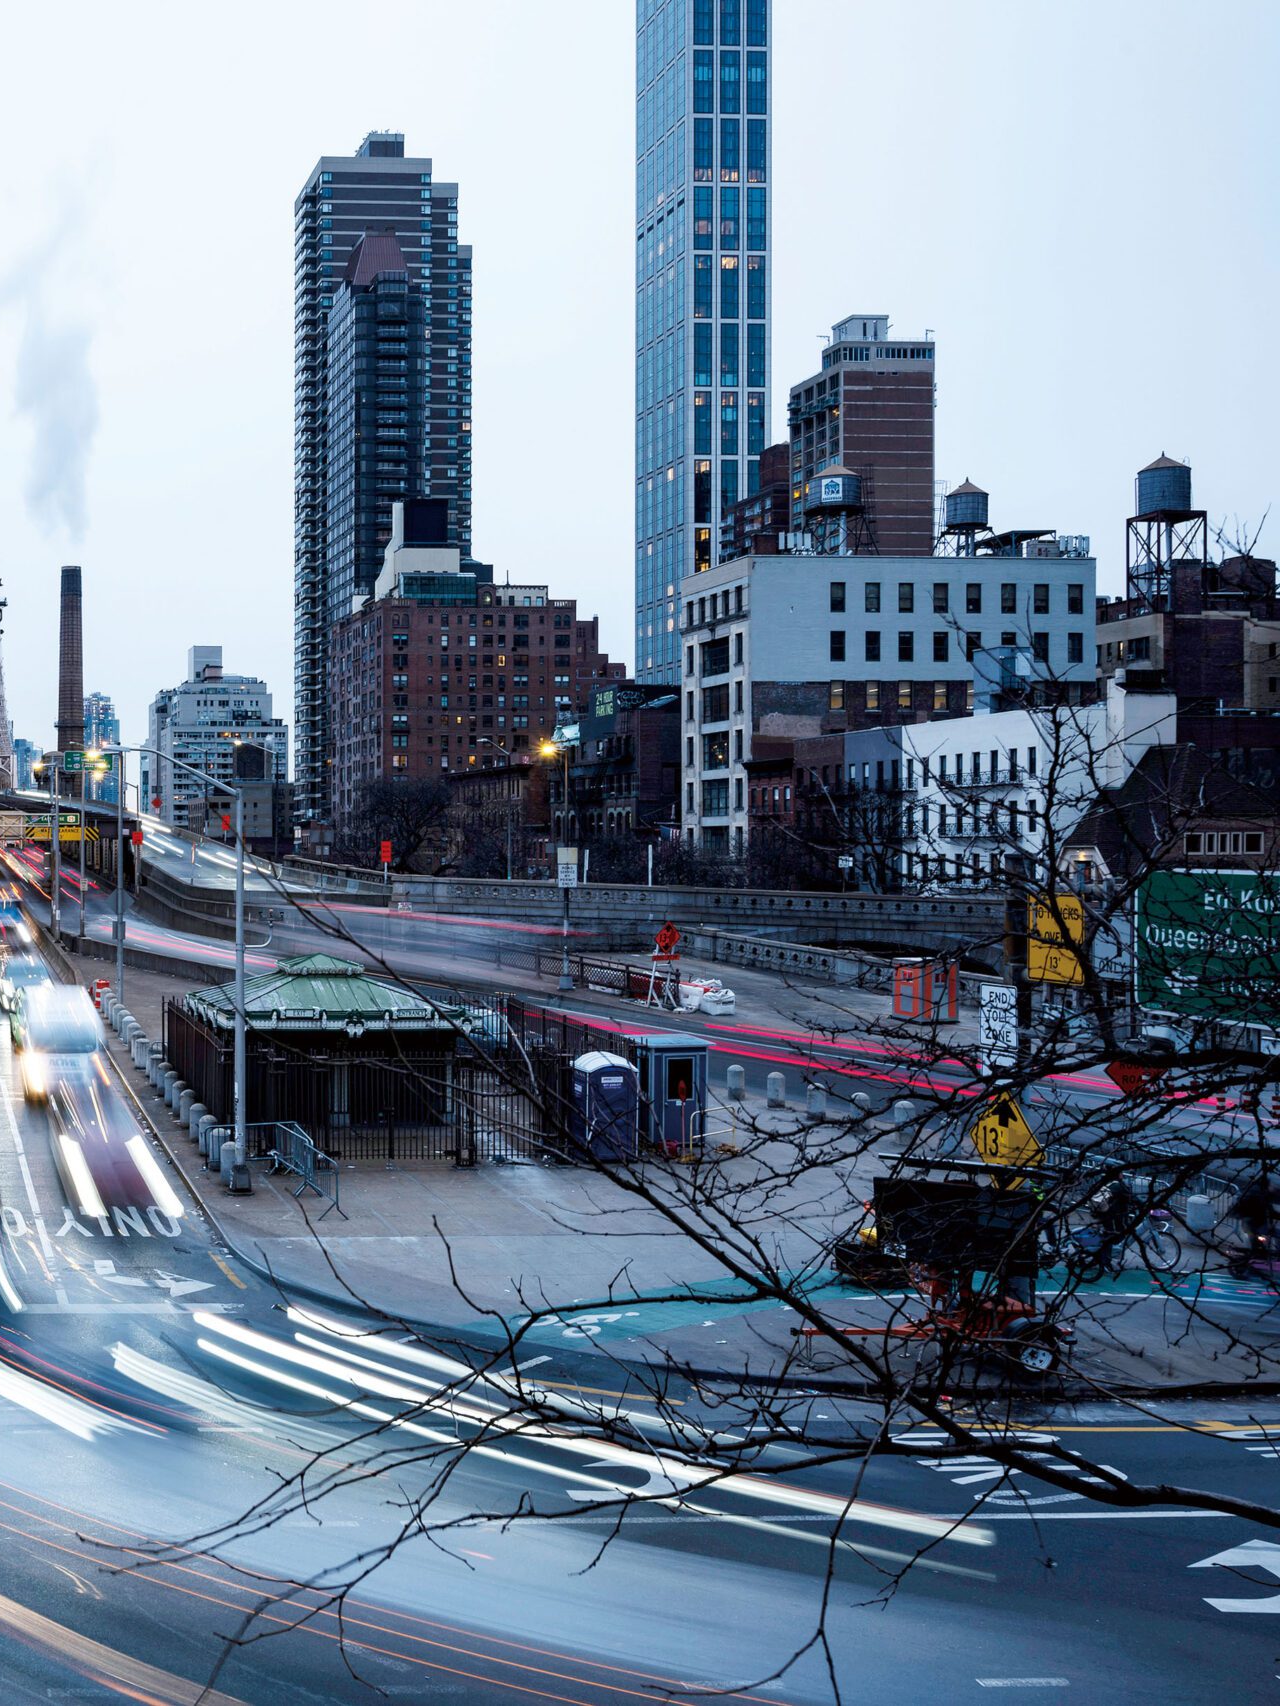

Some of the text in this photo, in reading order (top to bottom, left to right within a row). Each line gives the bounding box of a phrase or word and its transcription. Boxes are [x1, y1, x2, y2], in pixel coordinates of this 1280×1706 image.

[596, 693, 603, 705] 24
[603, 691, 614, 703] HOUR
[595, 702, 614, 718] PARKING
[1099, 960, 1126, 973] ONLY
[989, 991, 1008, 1004] END
[986, 1009, 1007, 1022] TOLL
[985, 1029, 1012, 1043] ZONE
[55, 1205, 182, 1238] ONLY
